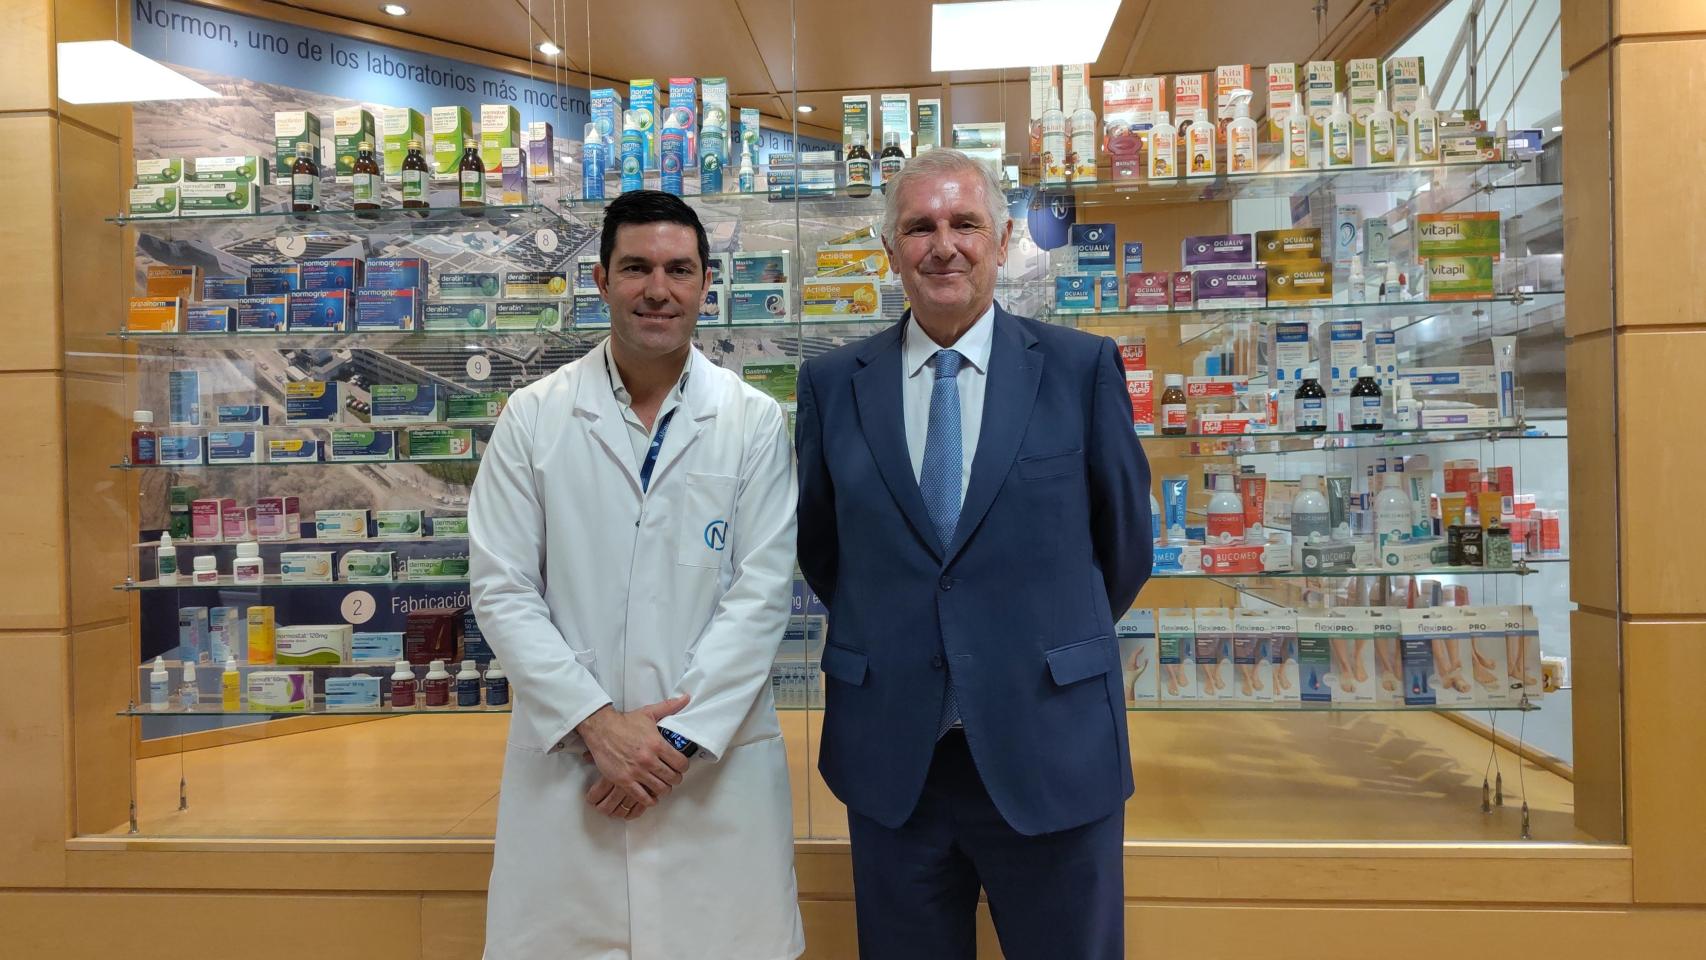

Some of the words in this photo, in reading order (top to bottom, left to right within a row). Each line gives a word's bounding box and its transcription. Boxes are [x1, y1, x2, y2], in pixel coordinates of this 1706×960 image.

[136, 0, 238, 47] Normon,
[248, 30, 289, 55] uno
[297, 37, 322, 62] de
[330, 43, 359, 69] los
[367, 51, 476, 93] laboratorios
[483, 79, 517, 101] más
[769, 132, 779, 149] la
[1420, 223, 1460, 237] vitapil
[286, 236, 294, 250] 2
[542, 234, 549, 246] 8
[1079, 244, 1110, 252] OCUALIV
[1431, 264, 1465, 276] vitapil
[441, 274, 466, 282] deratin
[1293, 271, 1325, 279] OCUALIV
[291, 290, 329, 298] normogrip
[358, 289, 397, 297] normogrip
[239, 297, 273, 305] normogrip
[425, 305, 451, 313] deratin
[497, 303, 524, 311] deratin
[474, 361, 482, 375] 9
[1152, 553, 1175, 561] OMED
[1216, 551, 1258, 562] BUCOMED
[352, 599, 362, 616] 2
[391, 590, 472, 614] Fabricación
[1117, 624, 1138, 632] iPRO
[1314, 622, 1354, 633] flexiPRO
[1418, 623, 1454, 632] flexiPRO
[1468, 623, 1487, 631] PRO
